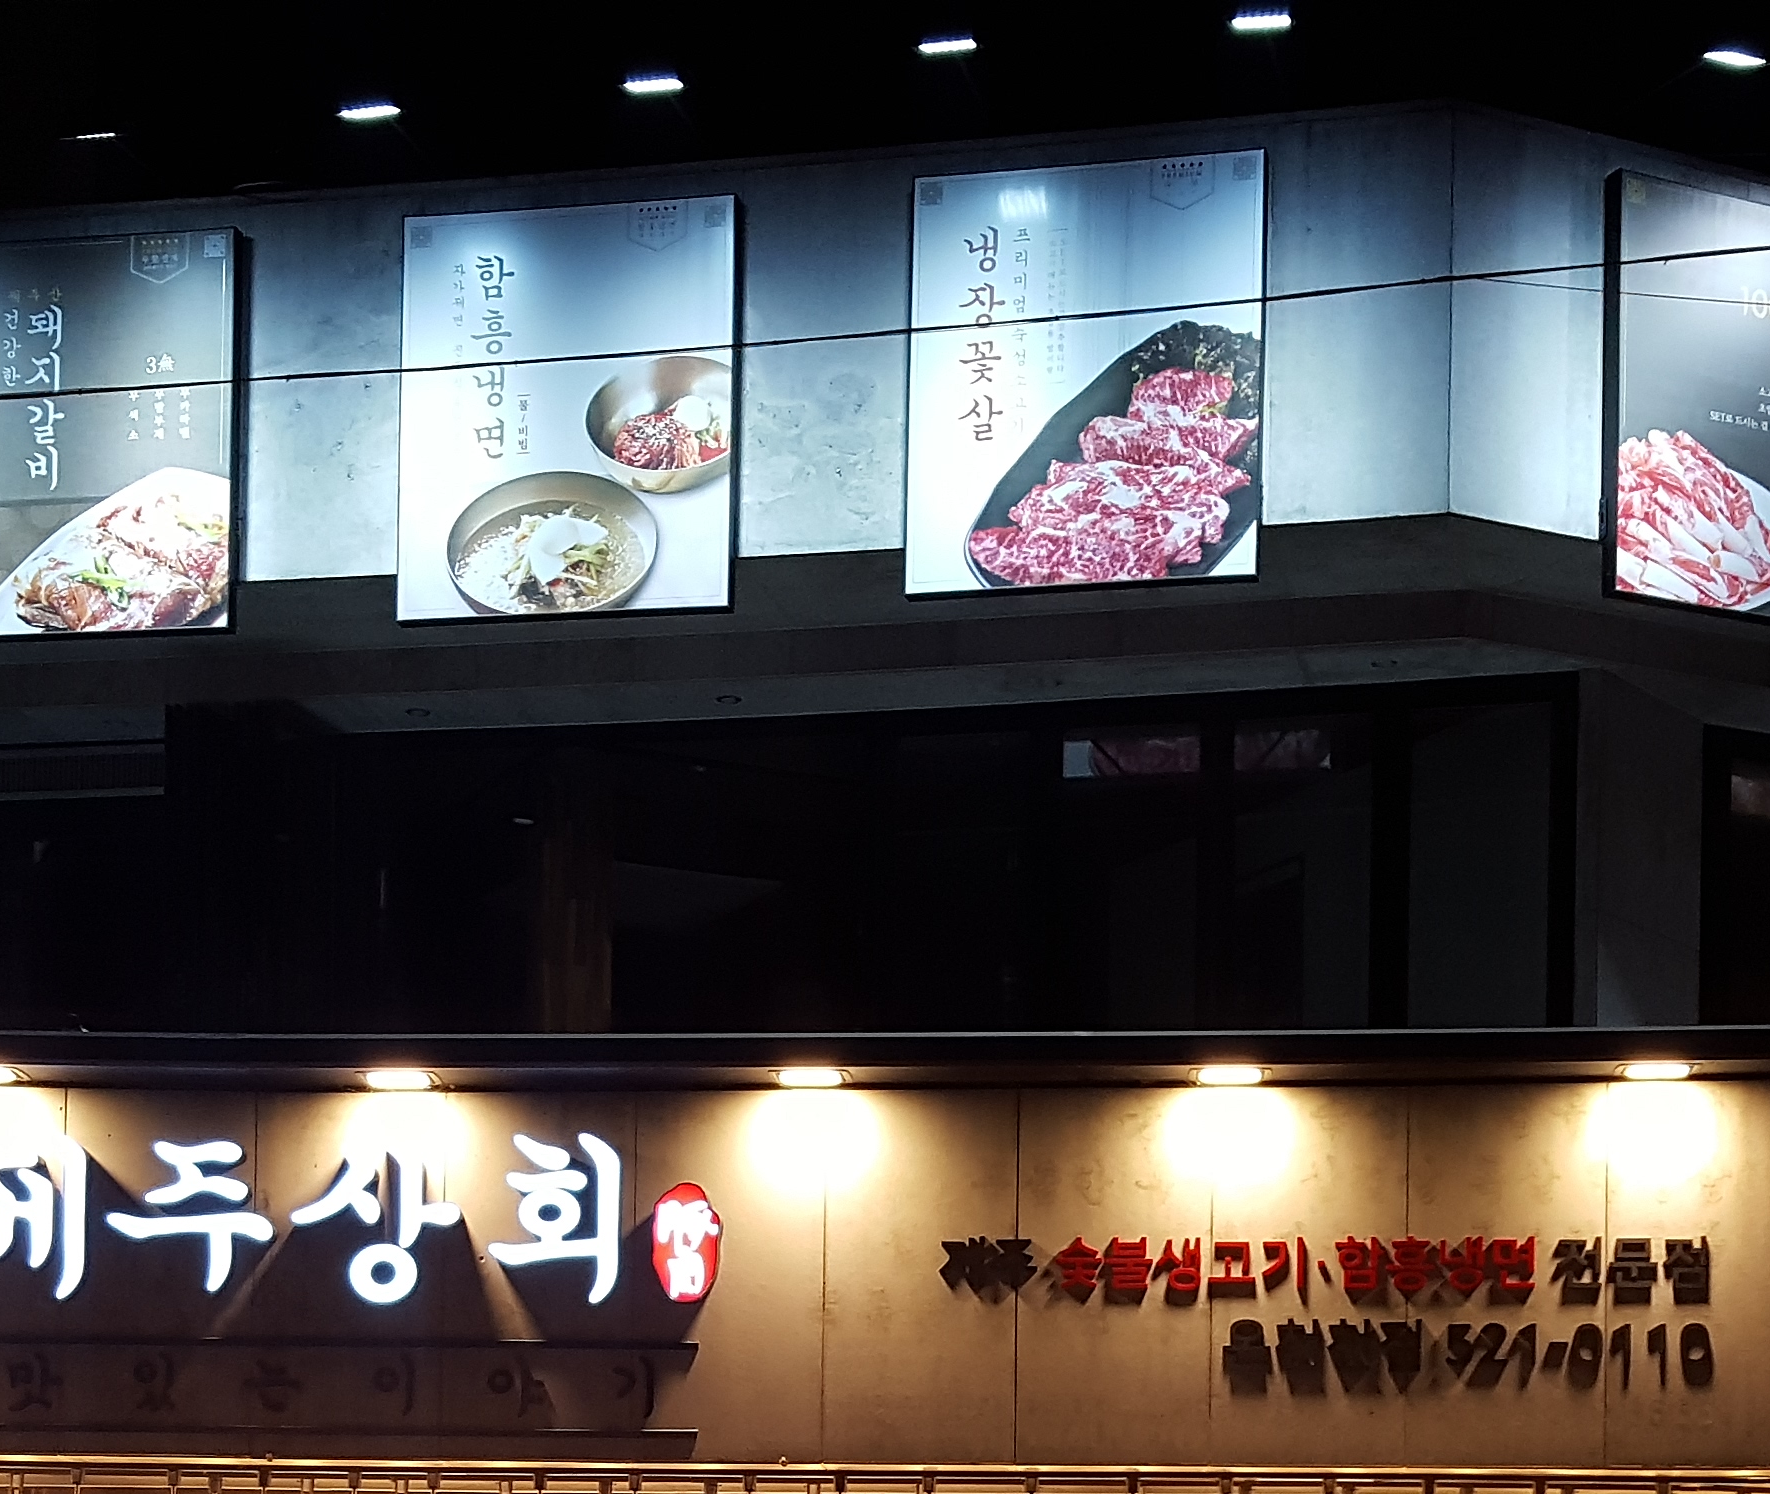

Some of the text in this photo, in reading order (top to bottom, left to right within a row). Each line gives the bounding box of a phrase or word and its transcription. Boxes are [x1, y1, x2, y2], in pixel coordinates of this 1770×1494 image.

[2, 308, 22, 388] 건강한
[23, 303, 66, 492] 돼지갈비
[470, 254, 516, 460] 함흥냉면
[958, 226, 1006, 442] 냉장꽃살
[1549, 1235, 1711, 1305] 전문점
[1446, 1322, 1714, 1389] 521-0110
